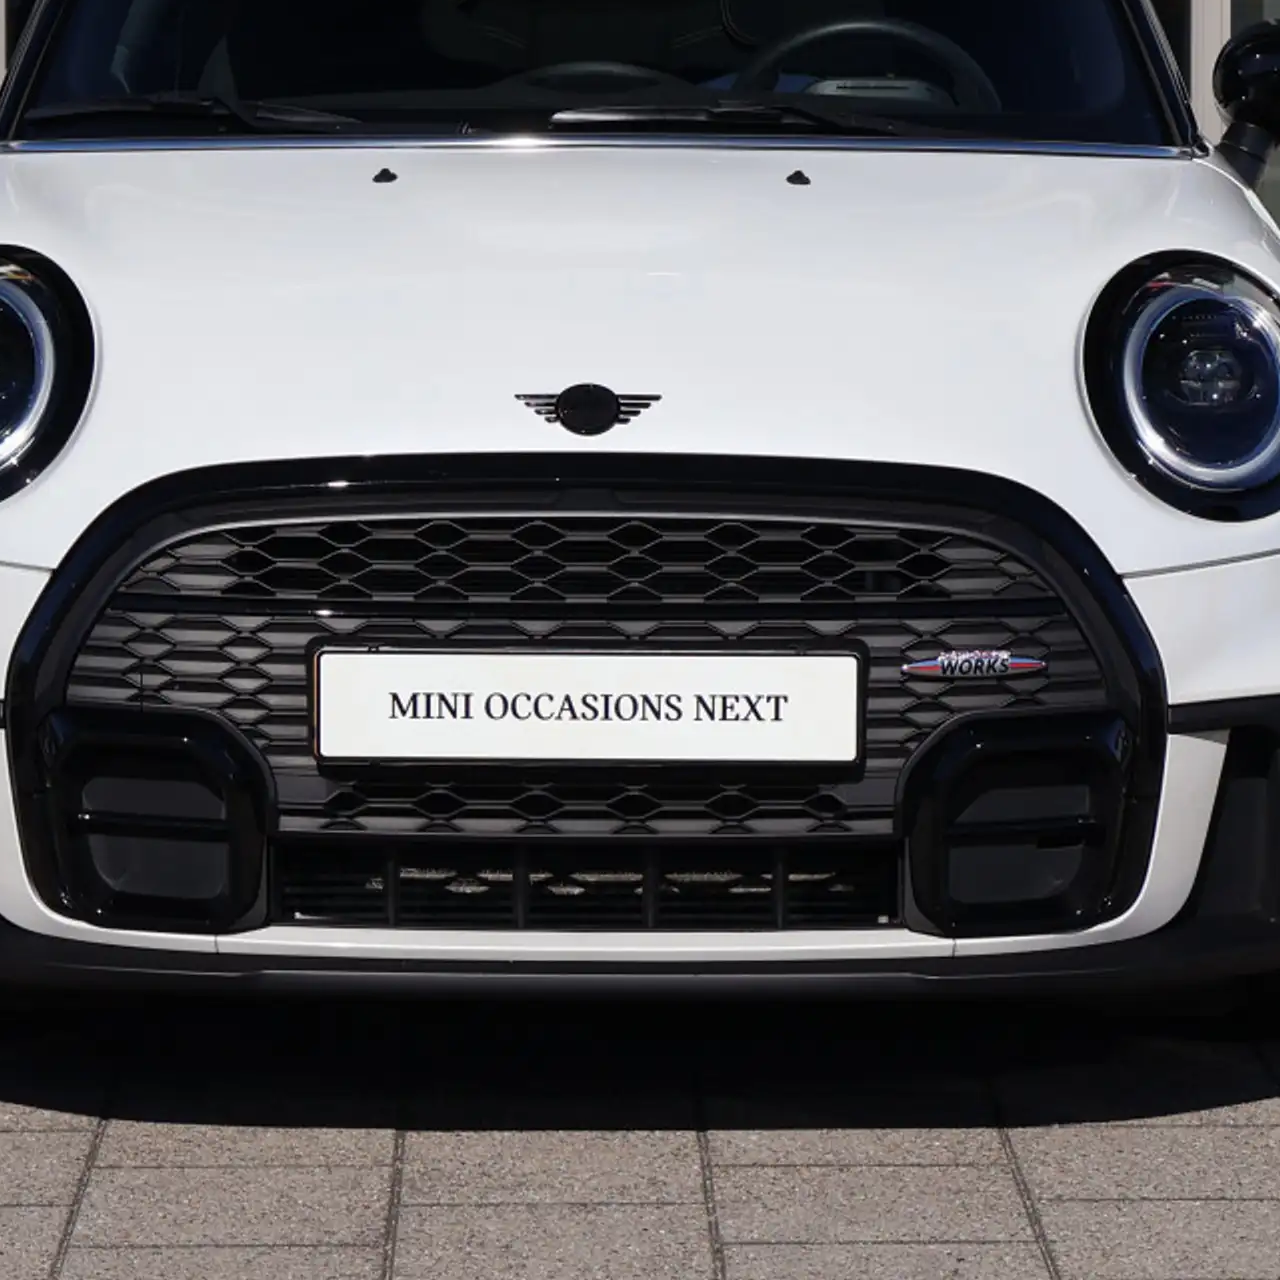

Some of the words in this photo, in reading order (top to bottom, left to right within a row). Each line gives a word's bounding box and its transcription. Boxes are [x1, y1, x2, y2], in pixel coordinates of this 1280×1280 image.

[940, 656, 1010, 676] WORKS
[388, 690, 474, 722] MINI
[485, 690, 684, 724] OCCASIONS
[692, 692, 788, 724] NEXT
